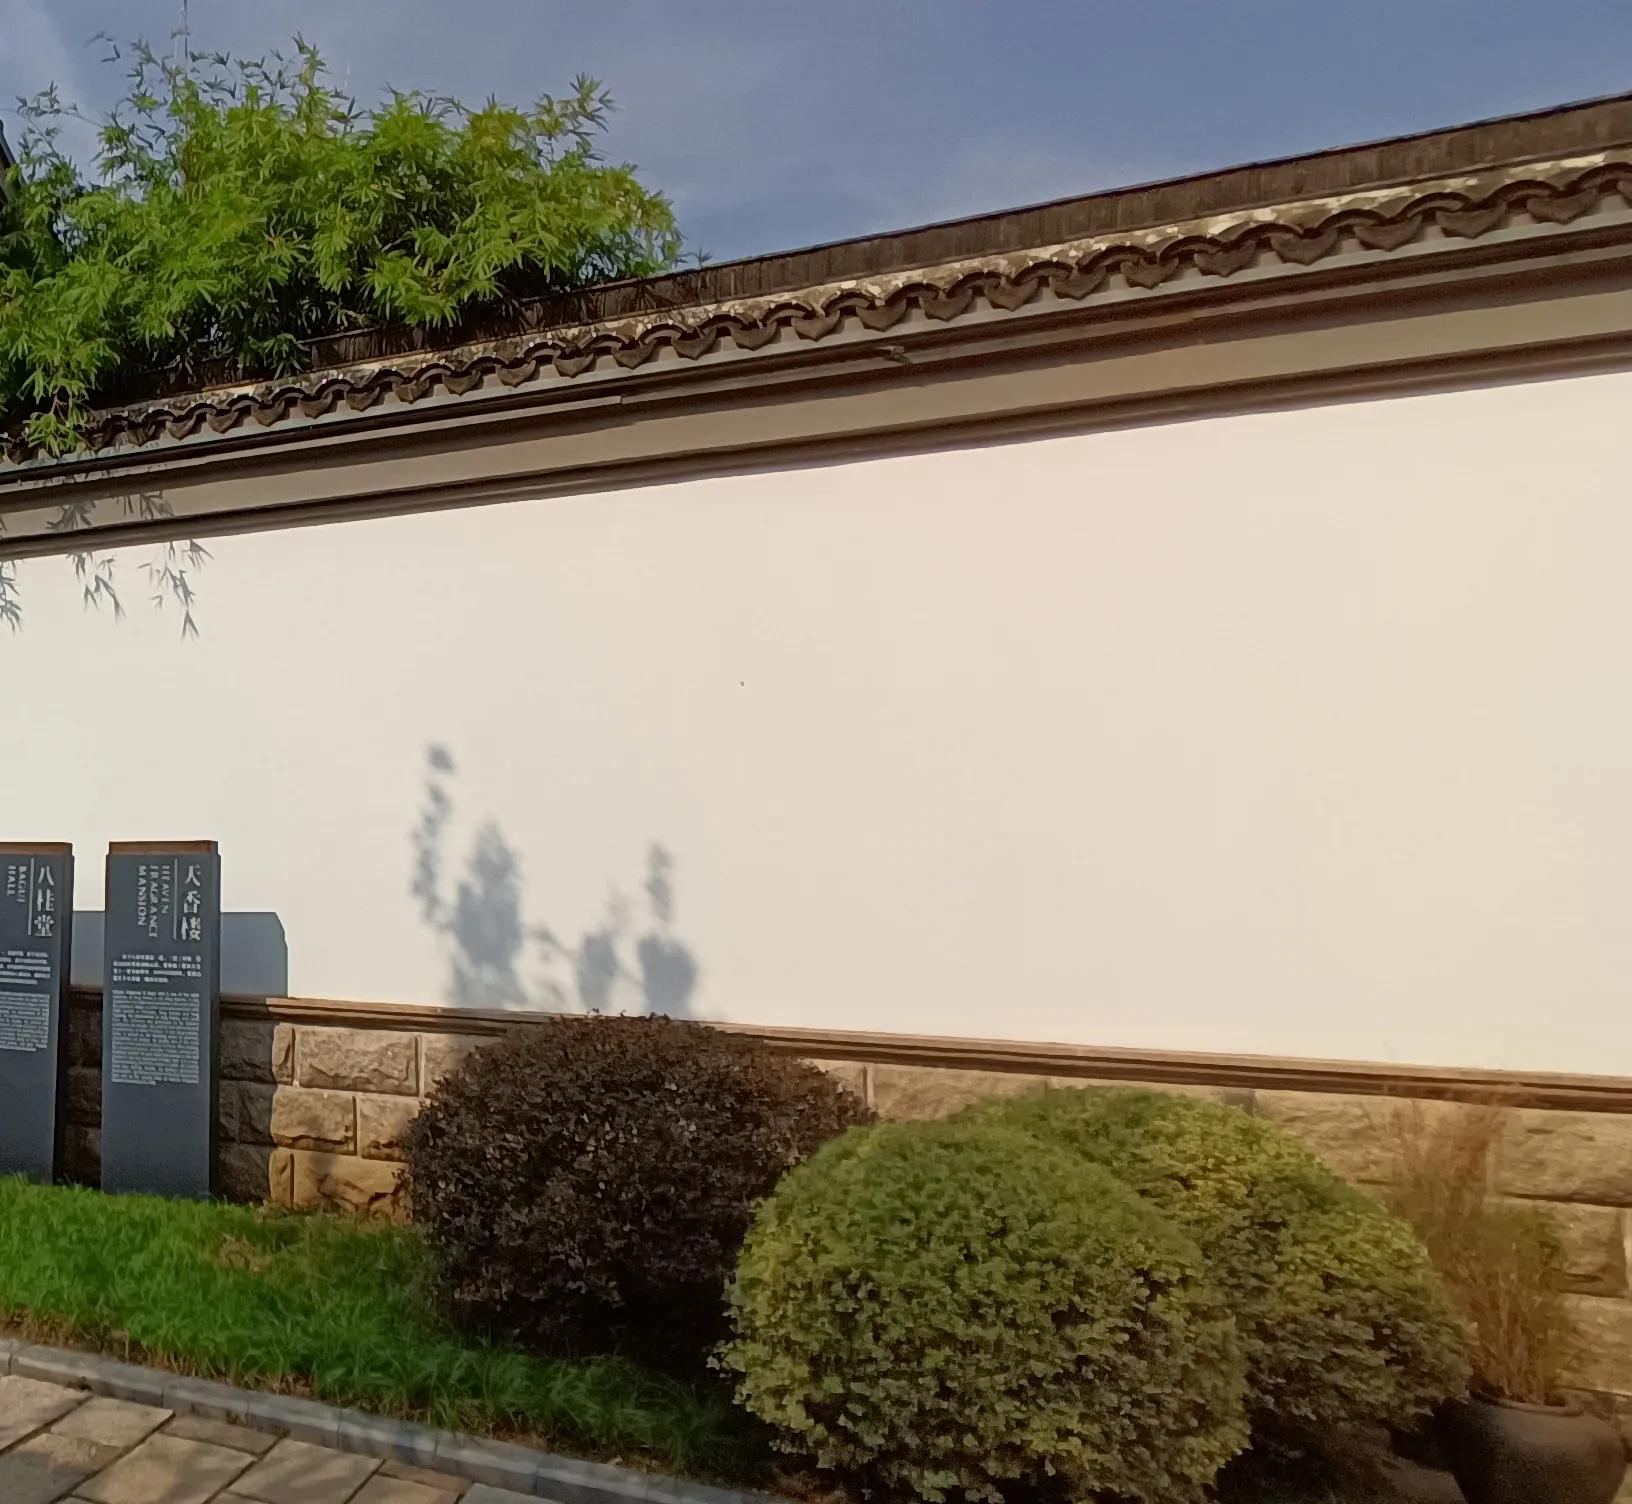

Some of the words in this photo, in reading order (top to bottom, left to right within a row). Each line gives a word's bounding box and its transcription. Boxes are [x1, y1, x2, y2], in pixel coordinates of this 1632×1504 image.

[6, 865, 16, 897] HALL
[16, 865, 27, 903] BAGUI
[33, 865, 56, 937] 八桂堂
[137, 865, 147, 927] MANSION
[180, 864, 202, 941] 天香楼
